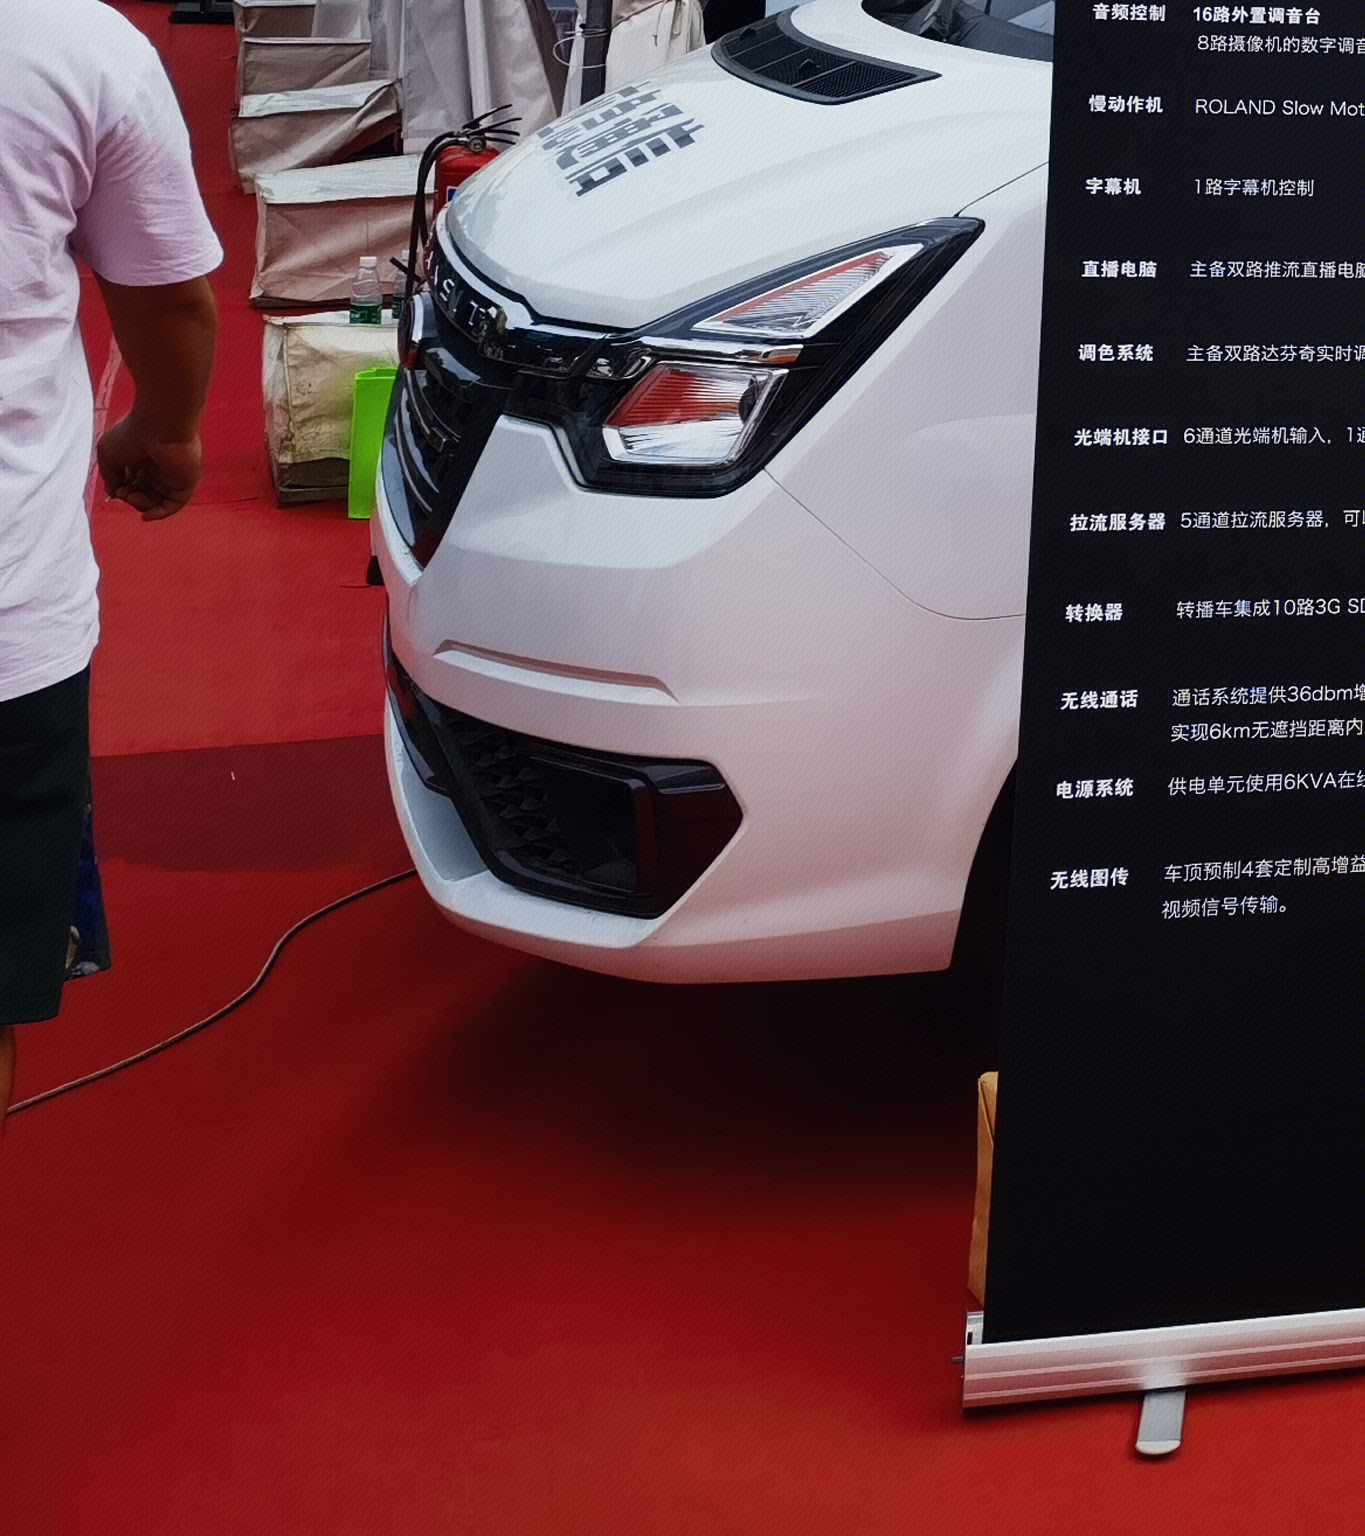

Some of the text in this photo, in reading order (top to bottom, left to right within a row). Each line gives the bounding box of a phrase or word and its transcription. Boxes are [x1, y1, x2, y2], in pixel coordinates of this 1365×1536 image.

[1093, 3, 1165, 21] 音频控制
[1193, 6, 1320, 24] 16路外置调音台
[1089, 95, 1163, 113] 慢动作机
[1195, 99, 1275, 114] ROLAND
[1282, 100, 1323, 115] Slow
[1086, 177, 1141, 195] 字幕机
[1195, 179, 1314, 196] 1路字幕机控制
[1082, 260, 1157, 278] 直播电脑
[1079, 344, 1153, 361] 调色系统
[1074, 428, 1167, 446] 光端机接口
[1070, 513, 1165, 531] 拉流服务器
[1066, 603, 1122, 622] 转换器
[1061, 690, 1138, 710] 无线通话
[1057, 778, 1133, 798] 电源系统
[1051, 867, 1128, 889] 无线图传
[1162, 895, 1286, 919] 视频信号传输。
